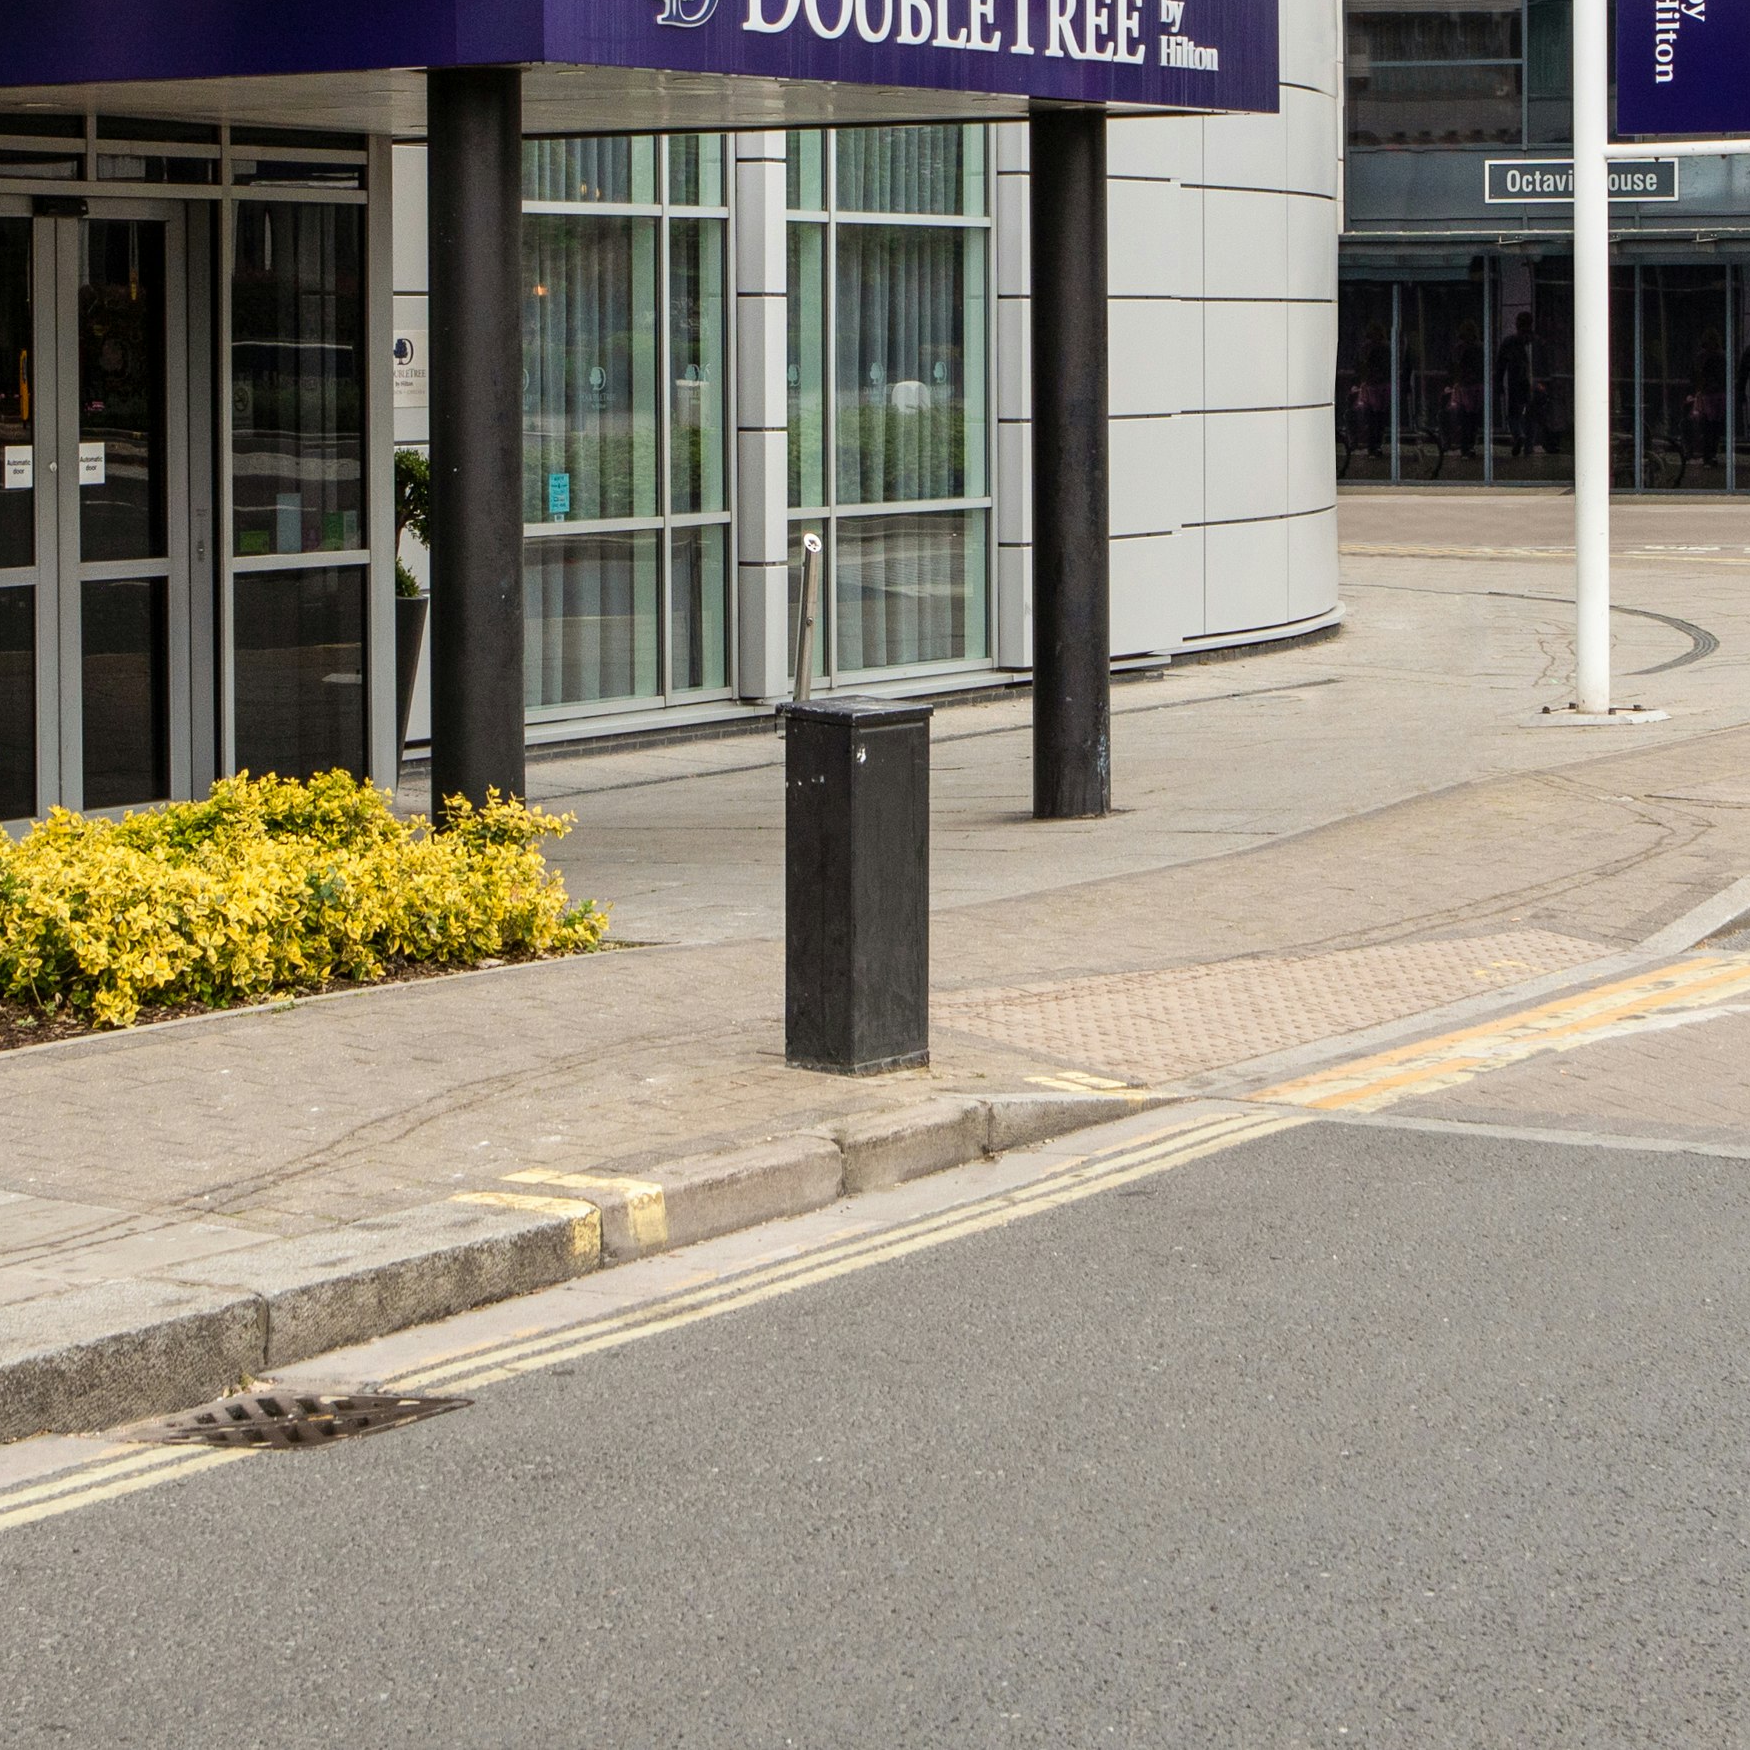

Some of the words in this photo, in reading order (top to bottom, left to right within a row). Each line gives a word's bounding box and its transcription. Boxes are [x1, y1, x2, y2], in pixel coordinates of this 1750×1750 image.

[1160, 35, 1219, 71] Hilton
[1506, 169, 1574, 192] Octavi
[1608, 172, 1658, 191] ouse
